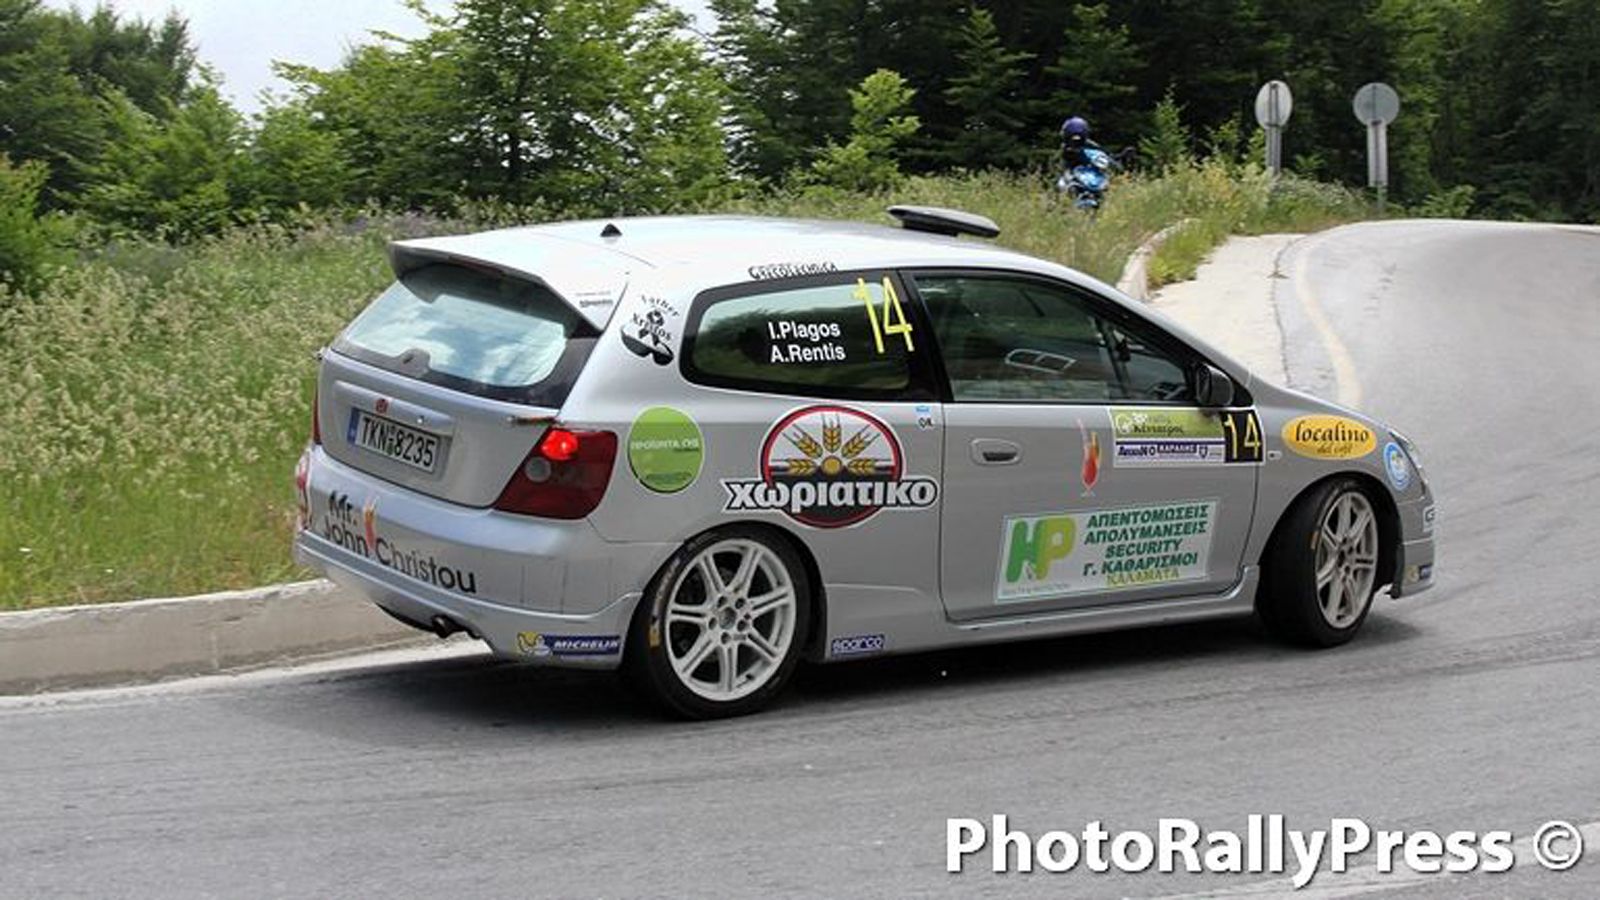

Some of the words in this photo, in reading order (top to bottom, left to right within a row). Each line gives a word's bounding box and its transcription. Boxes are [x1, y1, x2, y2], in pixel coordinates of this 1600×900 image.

[850, 277, 914, 353] 14
[768, 321, 841, 342] I.Plagos
[770, 343, 846, 364] A.Rentis
[1225, 412, 1261, 460] 14
[1295, 420, 1369, 443] localino
[324, 514, 370, 559] John
[375, 537, 477, 594] Christou
[1104, 537, 1184, 559] SECURITY
[1101, 551, 1199, 575] ΚΑΘΑΡΙΣΜΟΙ
